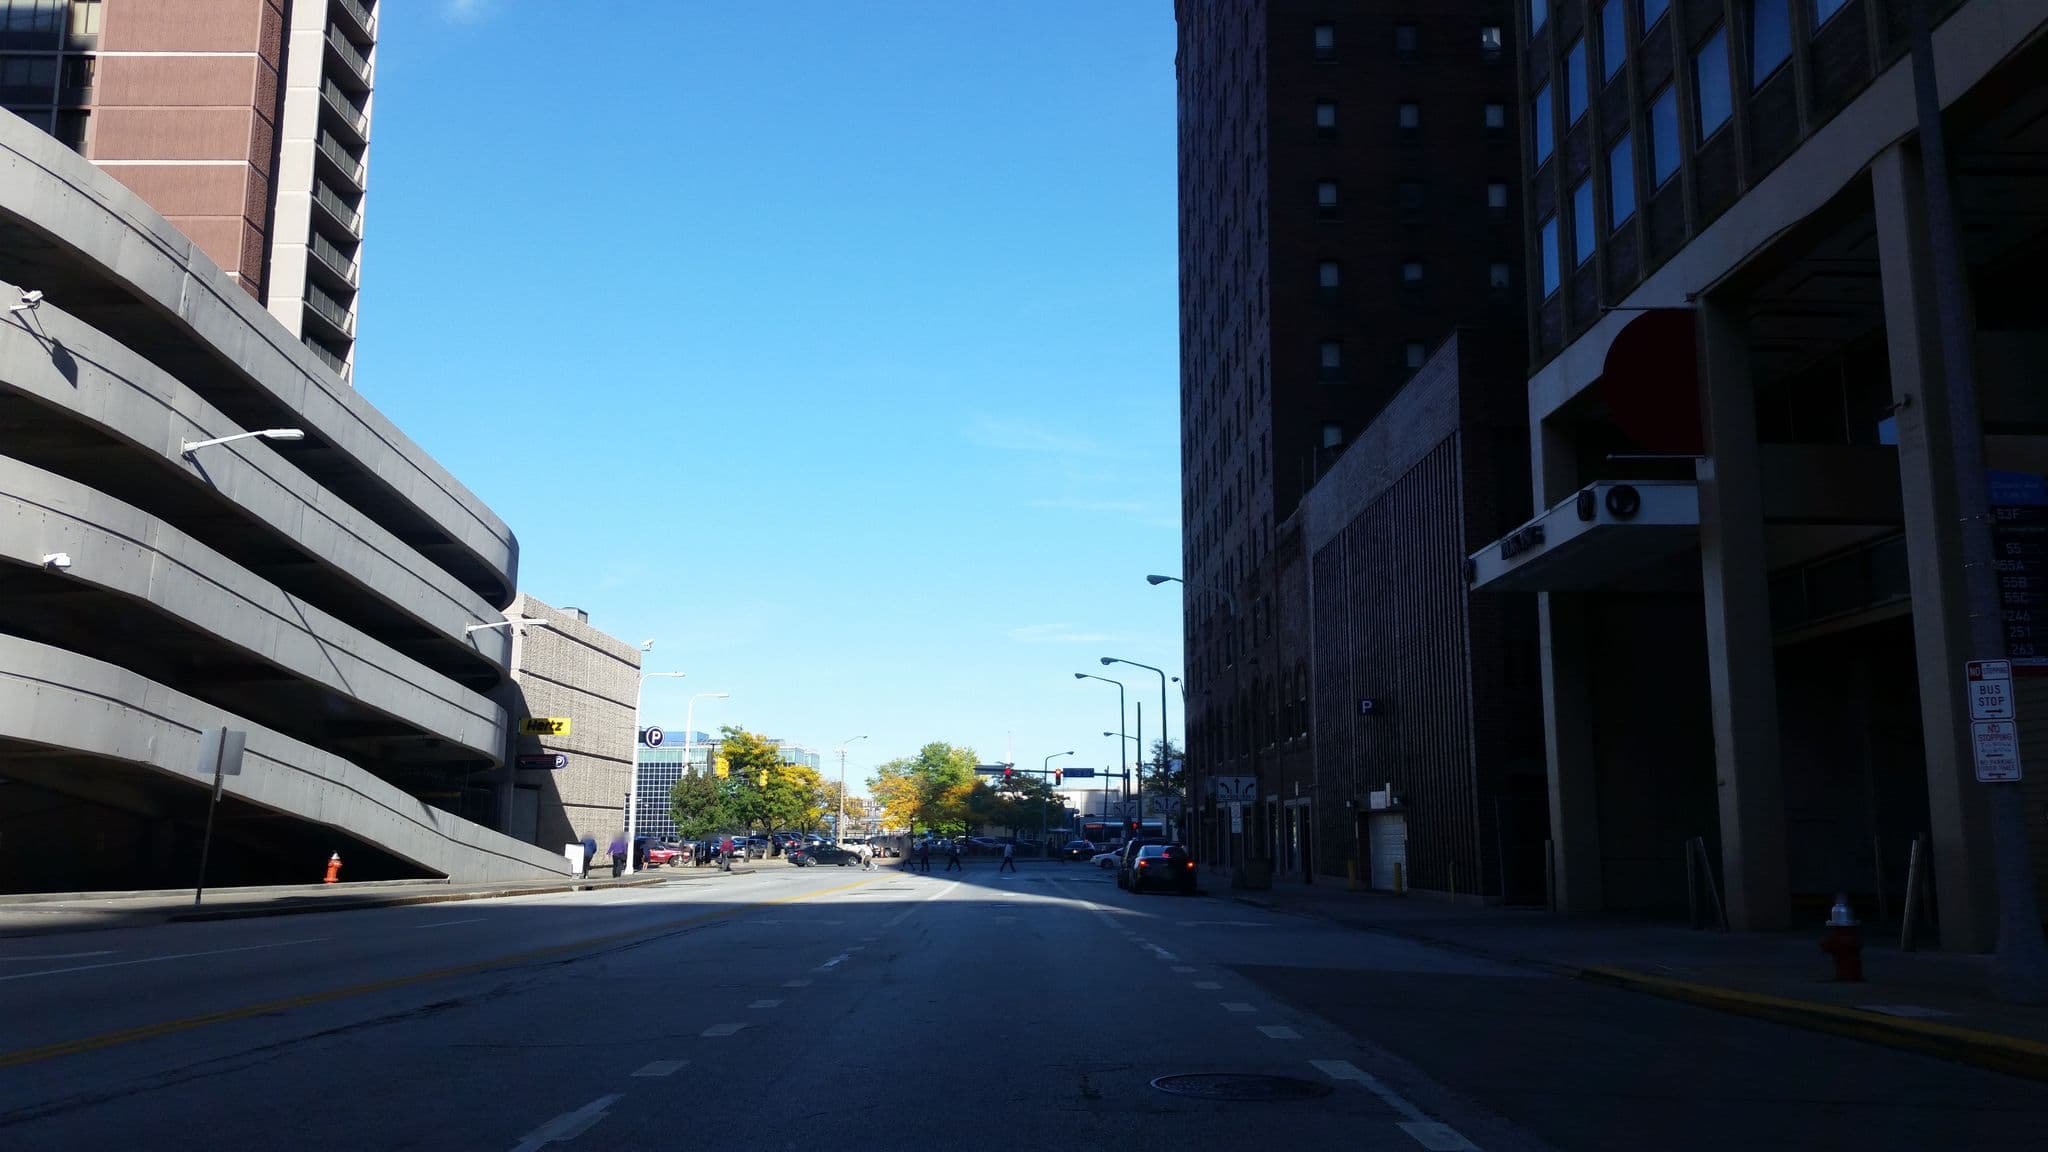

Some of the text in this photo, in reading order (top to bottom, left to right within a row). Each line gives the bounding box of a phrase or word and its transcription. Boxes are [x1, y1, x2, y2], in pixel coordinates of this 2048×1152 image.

[2006, 542, 2023, 554] 55
[1979, 685, 2001, 695] BUS
[1362, 700, 1373, 714] P
[1978, 697, 2005, 707] STOP
[526, 719, 564, 732] Hertz
[651, 731, 661, 744] P
